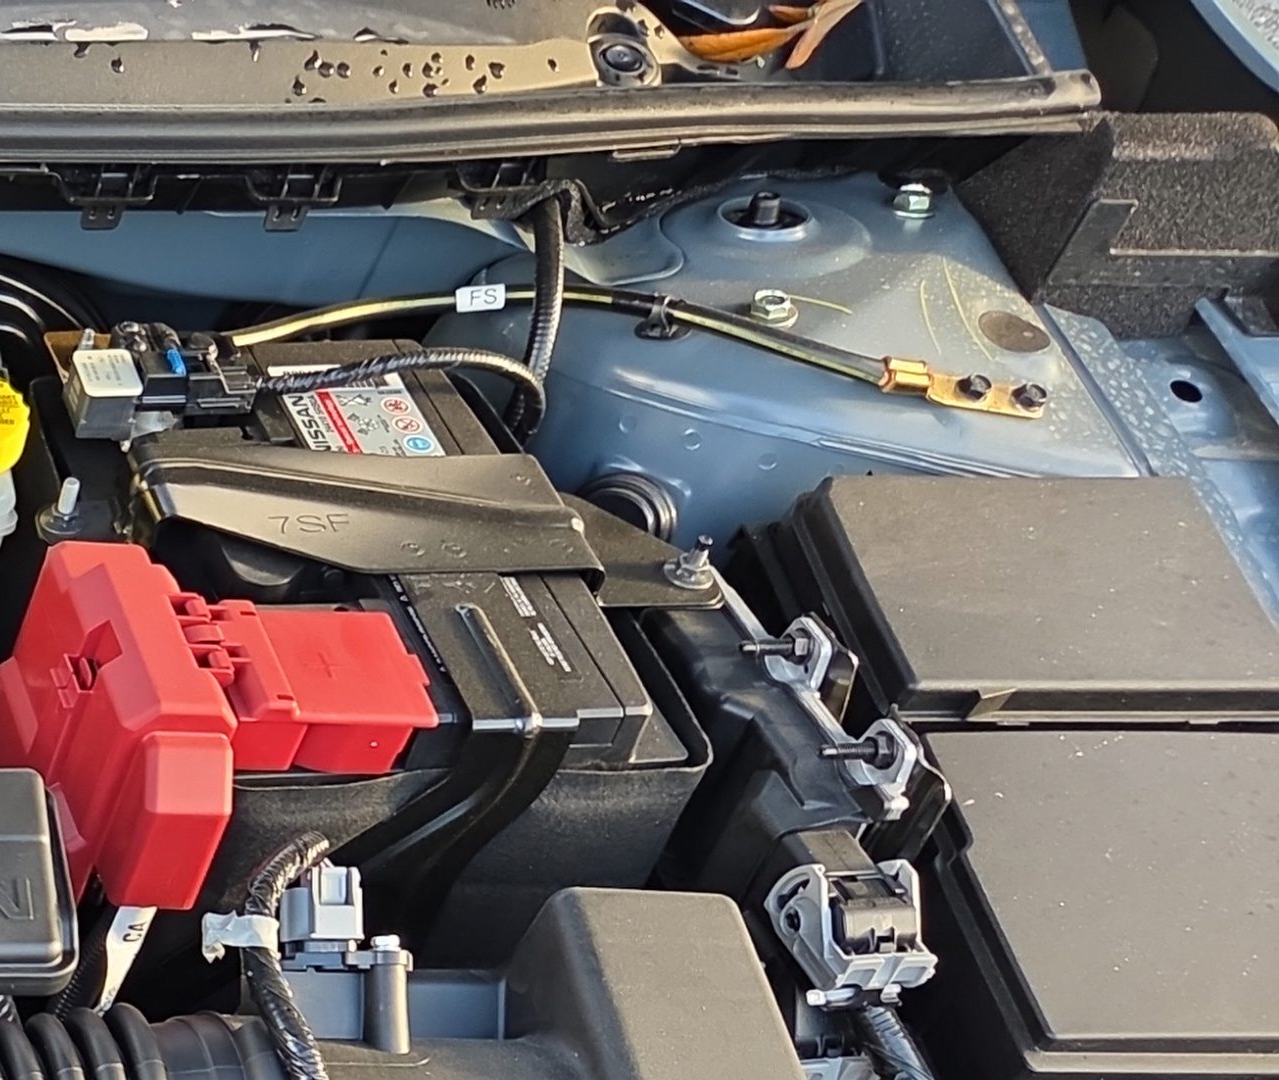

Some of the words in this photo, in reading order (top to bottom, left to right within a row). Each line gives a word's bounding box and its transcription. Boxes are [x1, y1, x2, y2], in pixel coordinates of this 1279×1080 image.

[469, 287, 498, 307] FS
[267, 513, 350, 534] 7SF
[122, 921, 147, 943] CA
